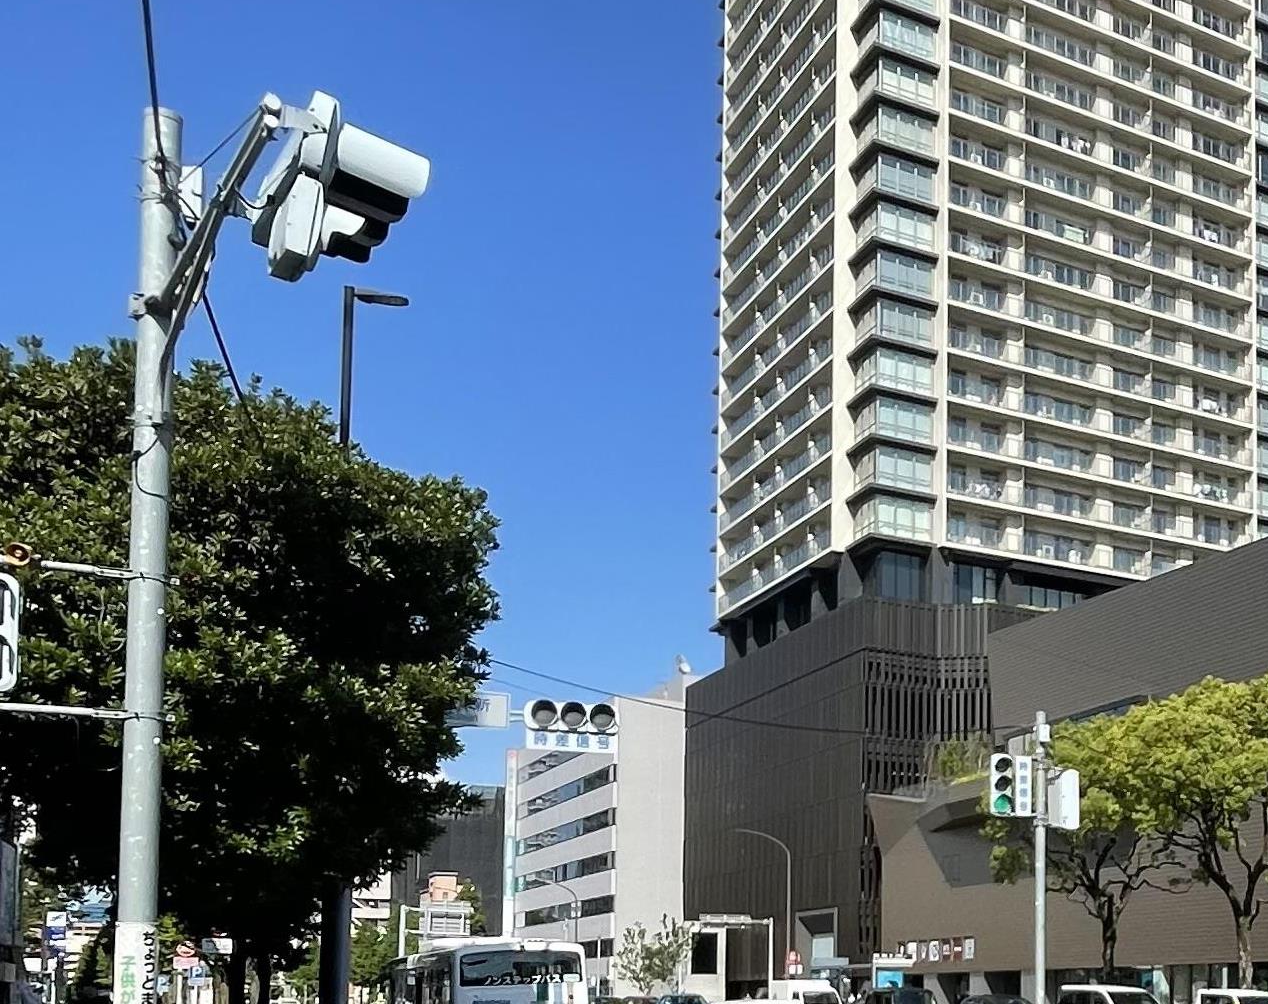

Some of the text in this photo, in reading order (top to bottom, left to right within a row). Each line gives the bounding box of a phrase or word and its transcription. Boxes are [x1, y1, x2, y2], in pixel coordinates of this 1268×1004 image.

[533, 732, 610, 750] 時差信号
[484, 974, 561, 986] ノンステップバス
